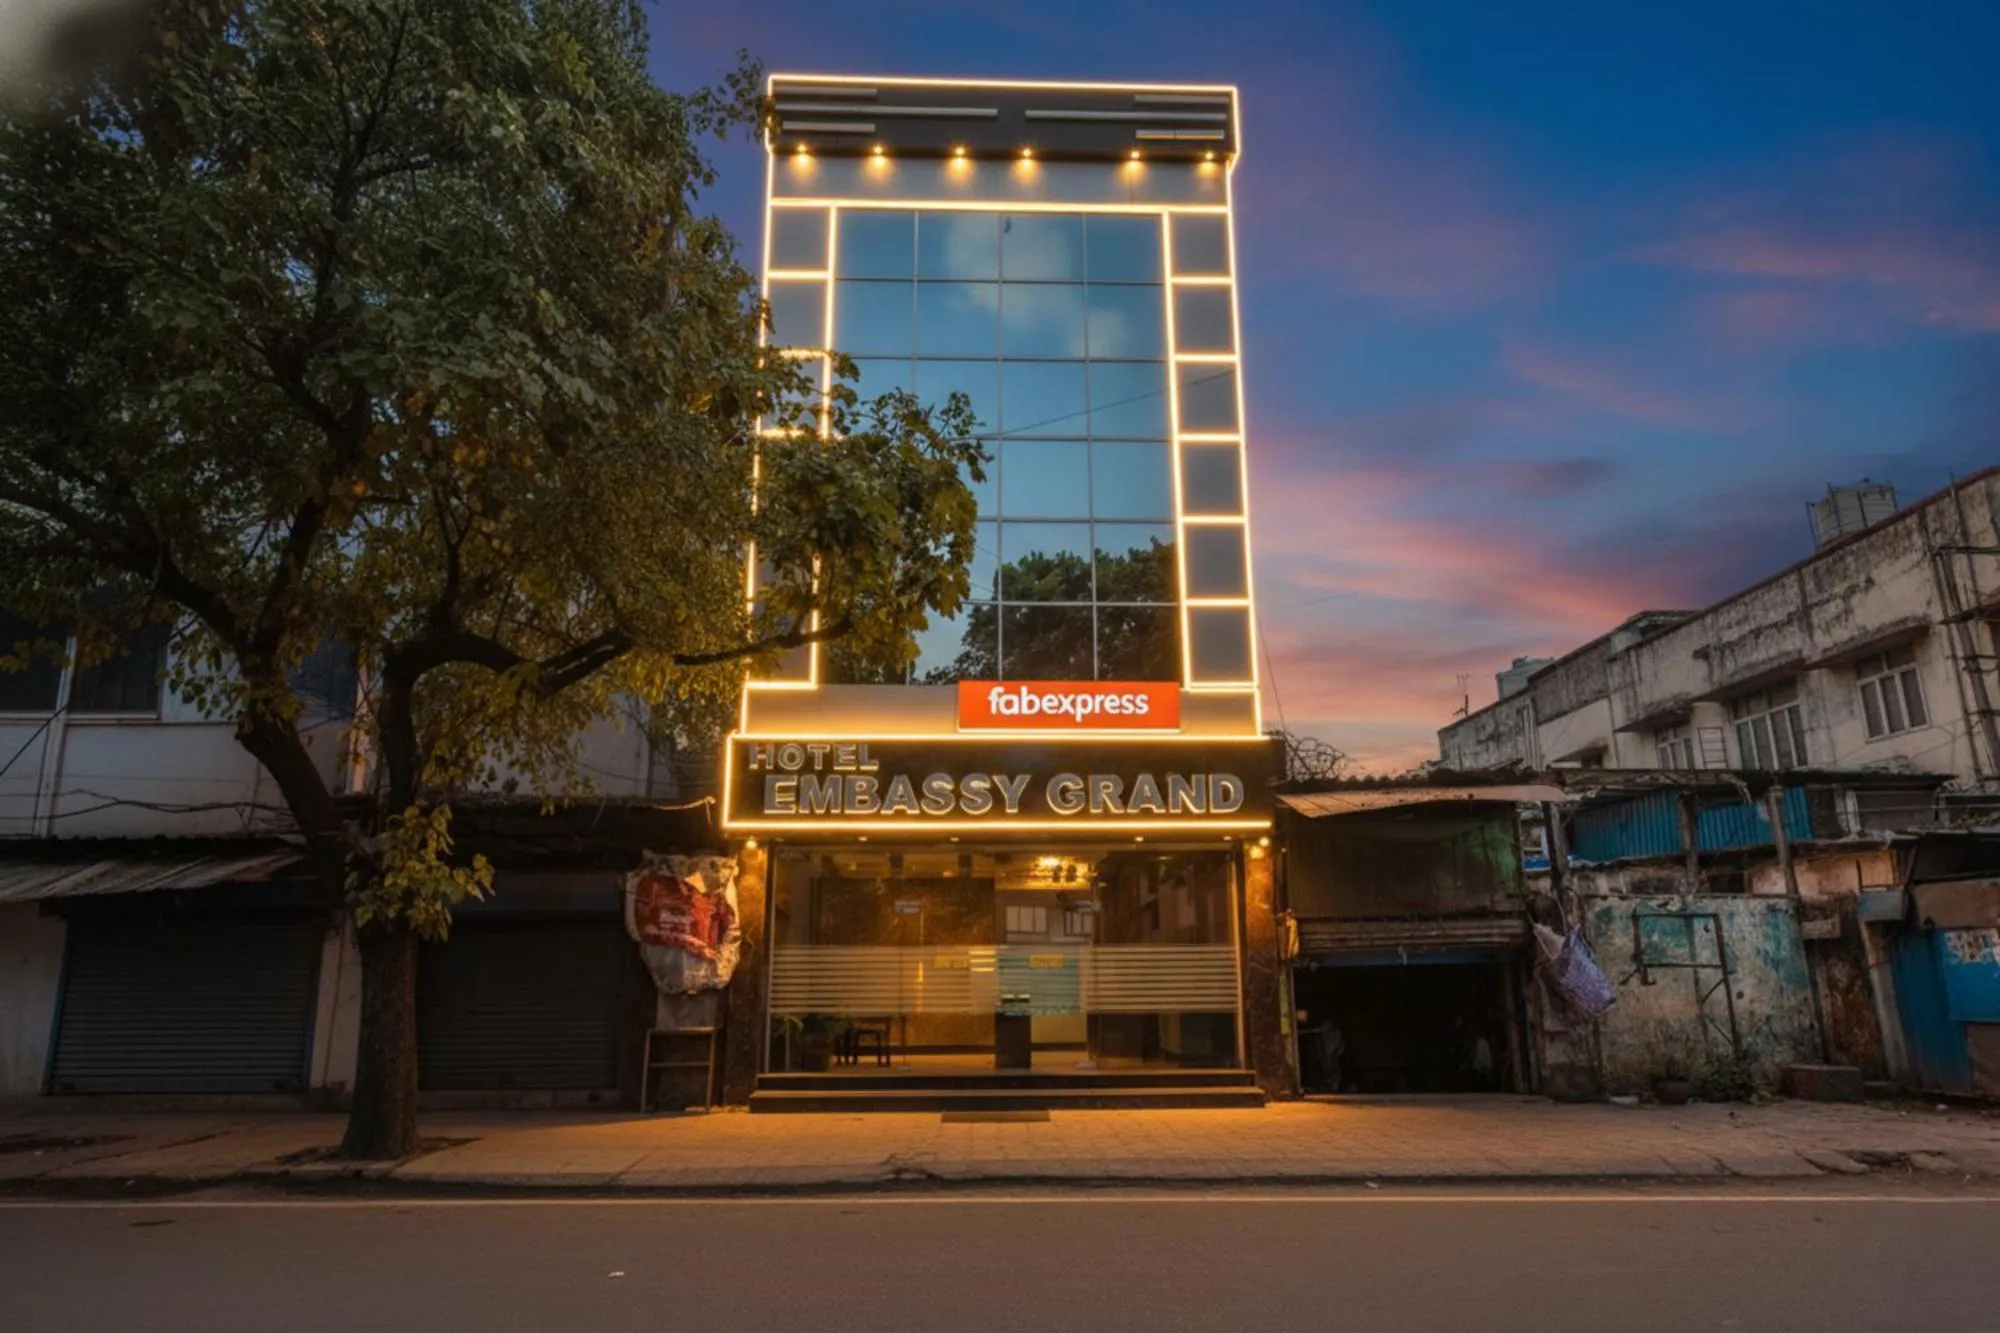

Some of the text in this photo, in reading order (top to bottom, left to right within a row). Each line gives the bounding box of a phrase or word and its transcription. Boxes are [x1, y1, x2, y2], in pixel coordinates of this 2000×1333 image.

[988, 686, 1149, 722] fabexpress
[749, 743, 879, 770] HOTEL
[764, 773, 1245, 815] EMBASSY GRAND
